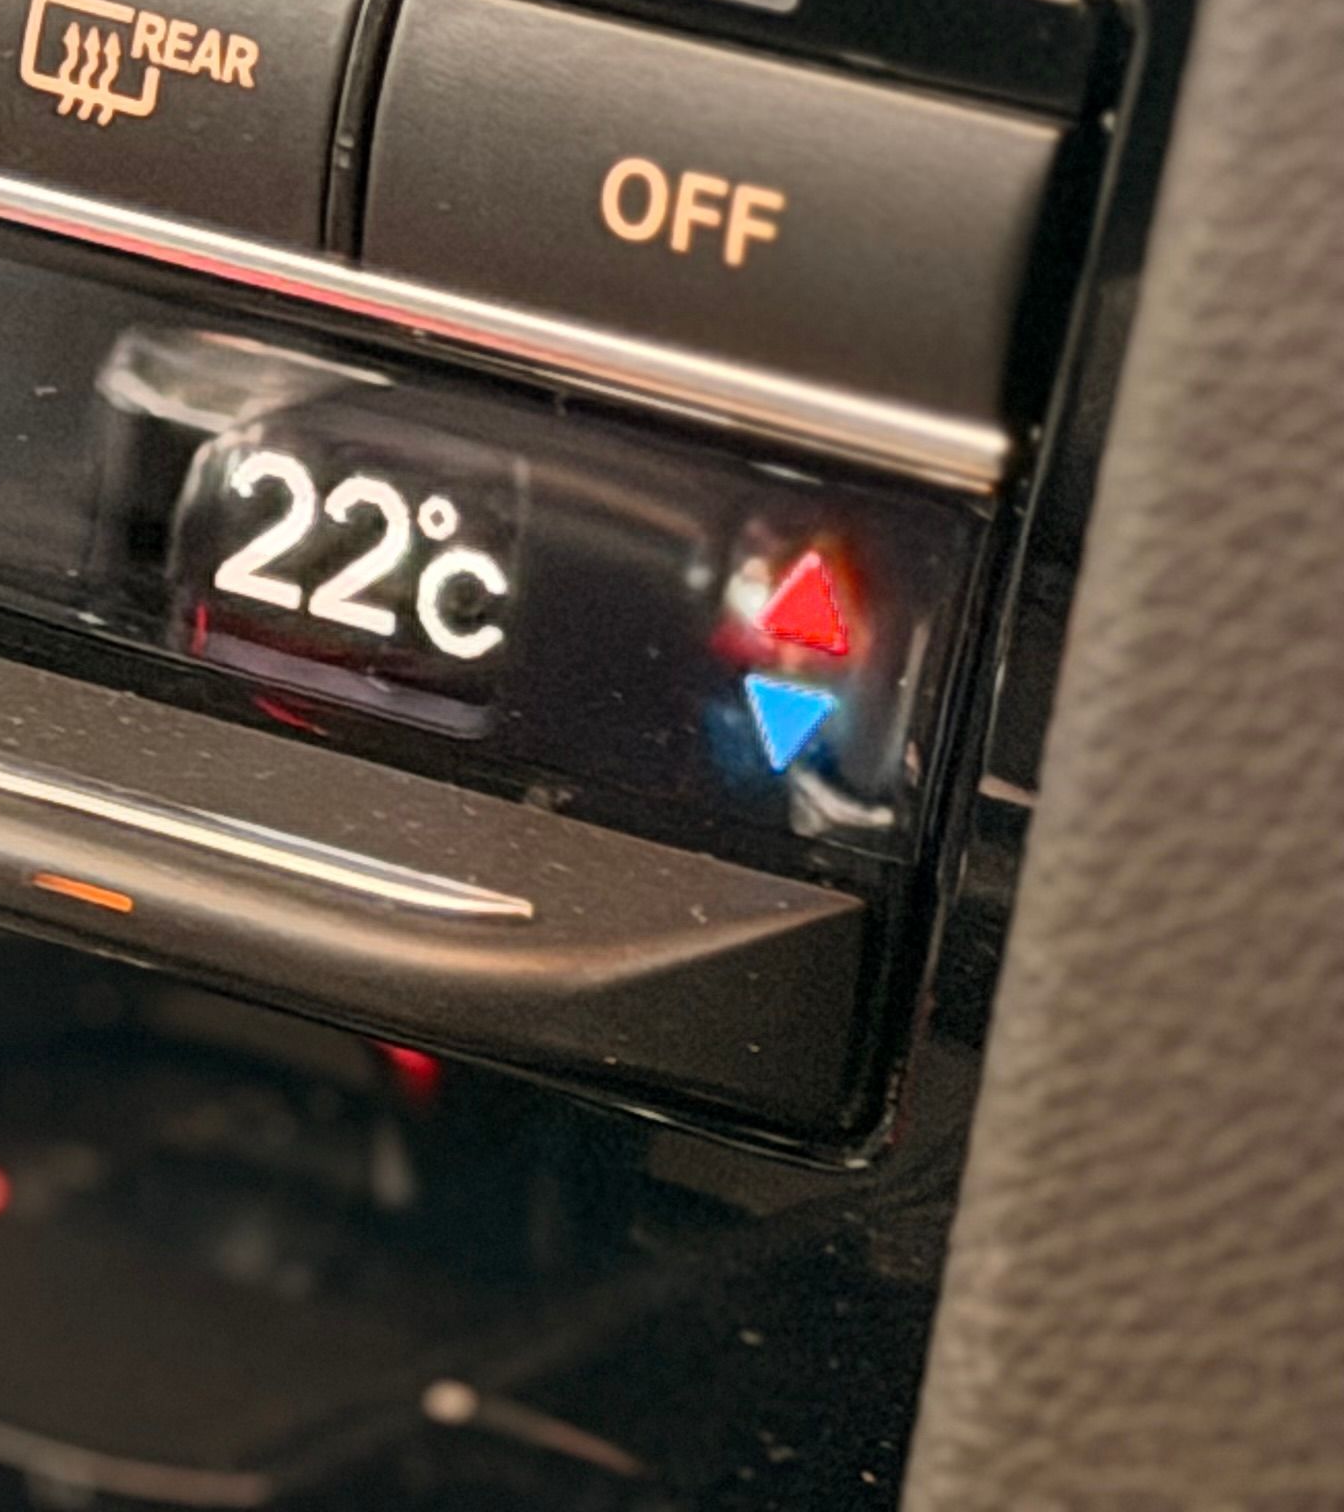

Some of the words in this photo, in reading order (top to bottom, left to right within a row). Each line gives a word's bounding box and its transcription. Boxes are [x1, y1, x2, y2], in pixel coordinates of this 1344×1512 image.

[130, 11, 259, 88] REAR
[600, 156, 785, 268] OFF
[213, 449, 509, 661] 22°C
